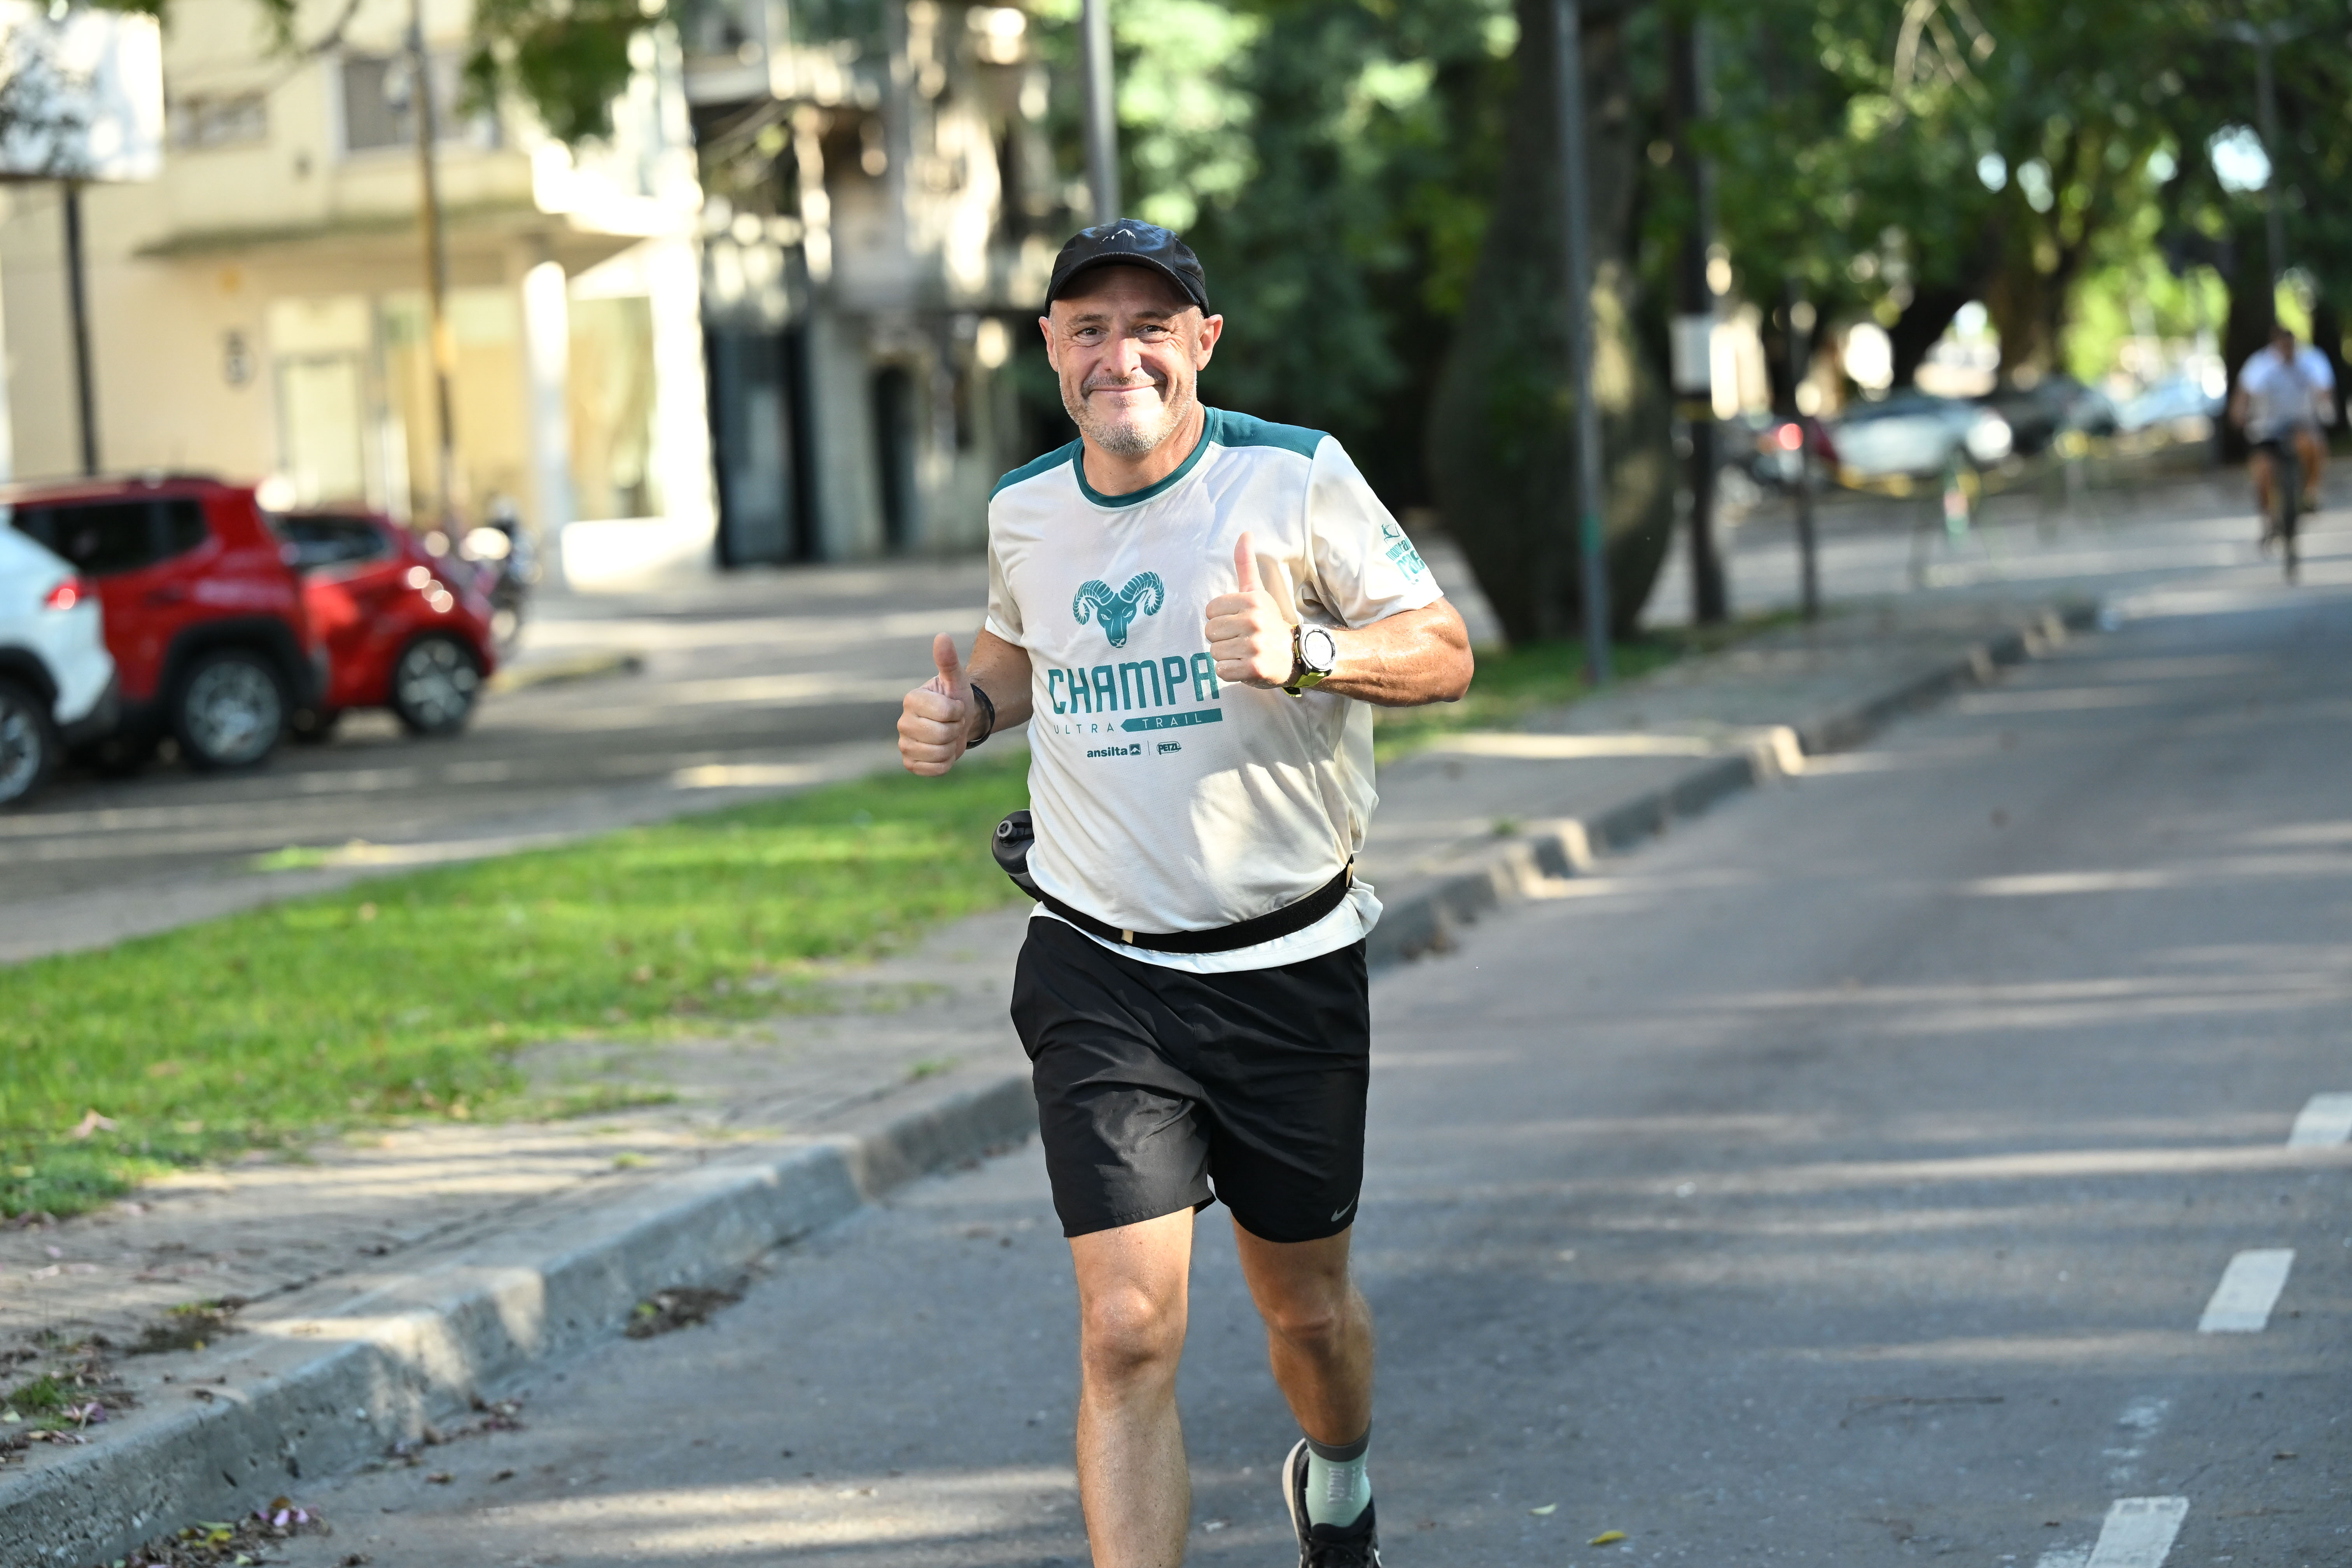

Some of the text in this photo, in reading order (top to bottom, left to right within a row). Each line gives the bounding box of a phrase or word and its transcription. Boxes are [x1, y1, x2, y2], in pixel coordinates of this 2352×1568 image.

[1048, 651, 1220, 714] CHAMPA
[1054, 713, 1202, 734] ULTRA TRAIL
[1087, 743, 1182, 758] ansilta PETZL
